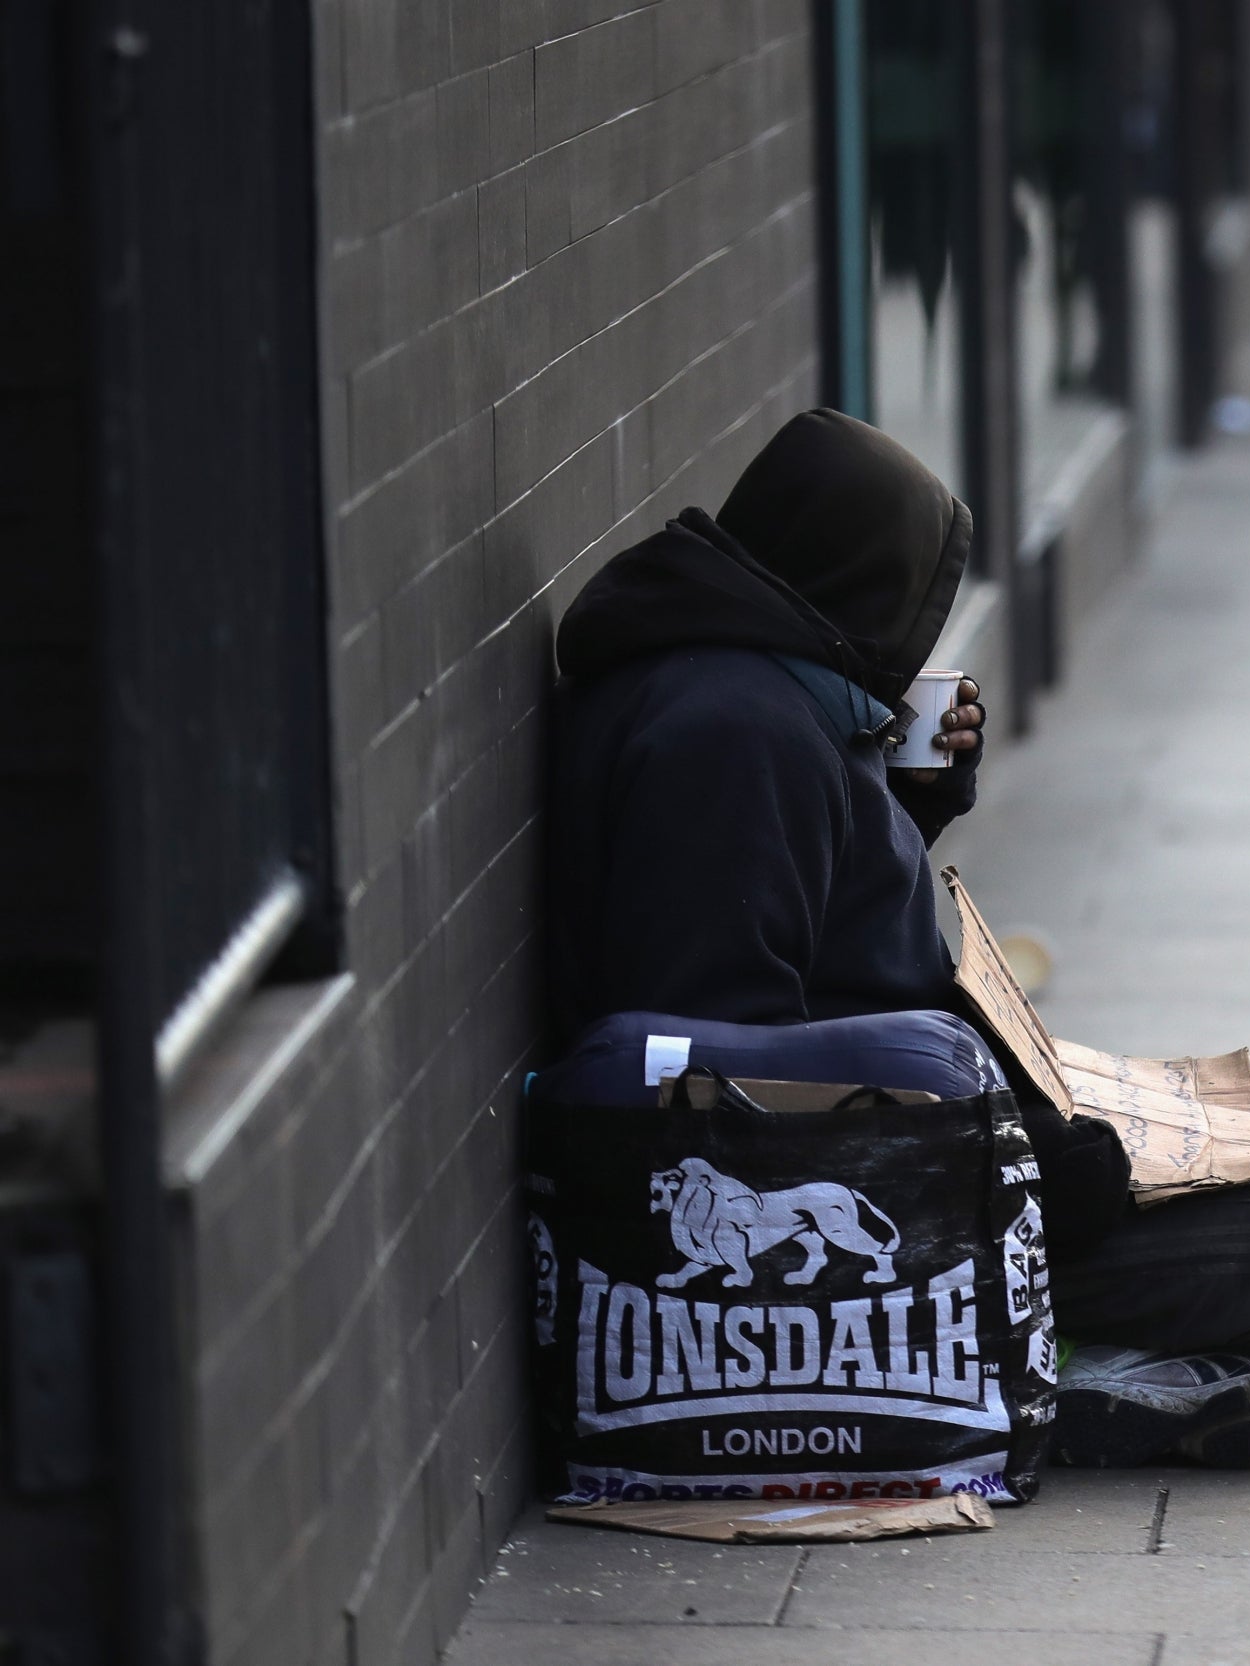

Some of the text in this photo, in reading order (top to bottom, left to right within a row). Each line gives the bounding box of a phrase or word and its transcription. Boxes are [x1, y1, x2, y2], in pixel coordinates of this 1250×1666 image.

[1009, 1217, 1034, 1313] BAG
[576, 1258, 992, 1420] LONSDALE
[701, 1426, 863, 1456] LONDON
